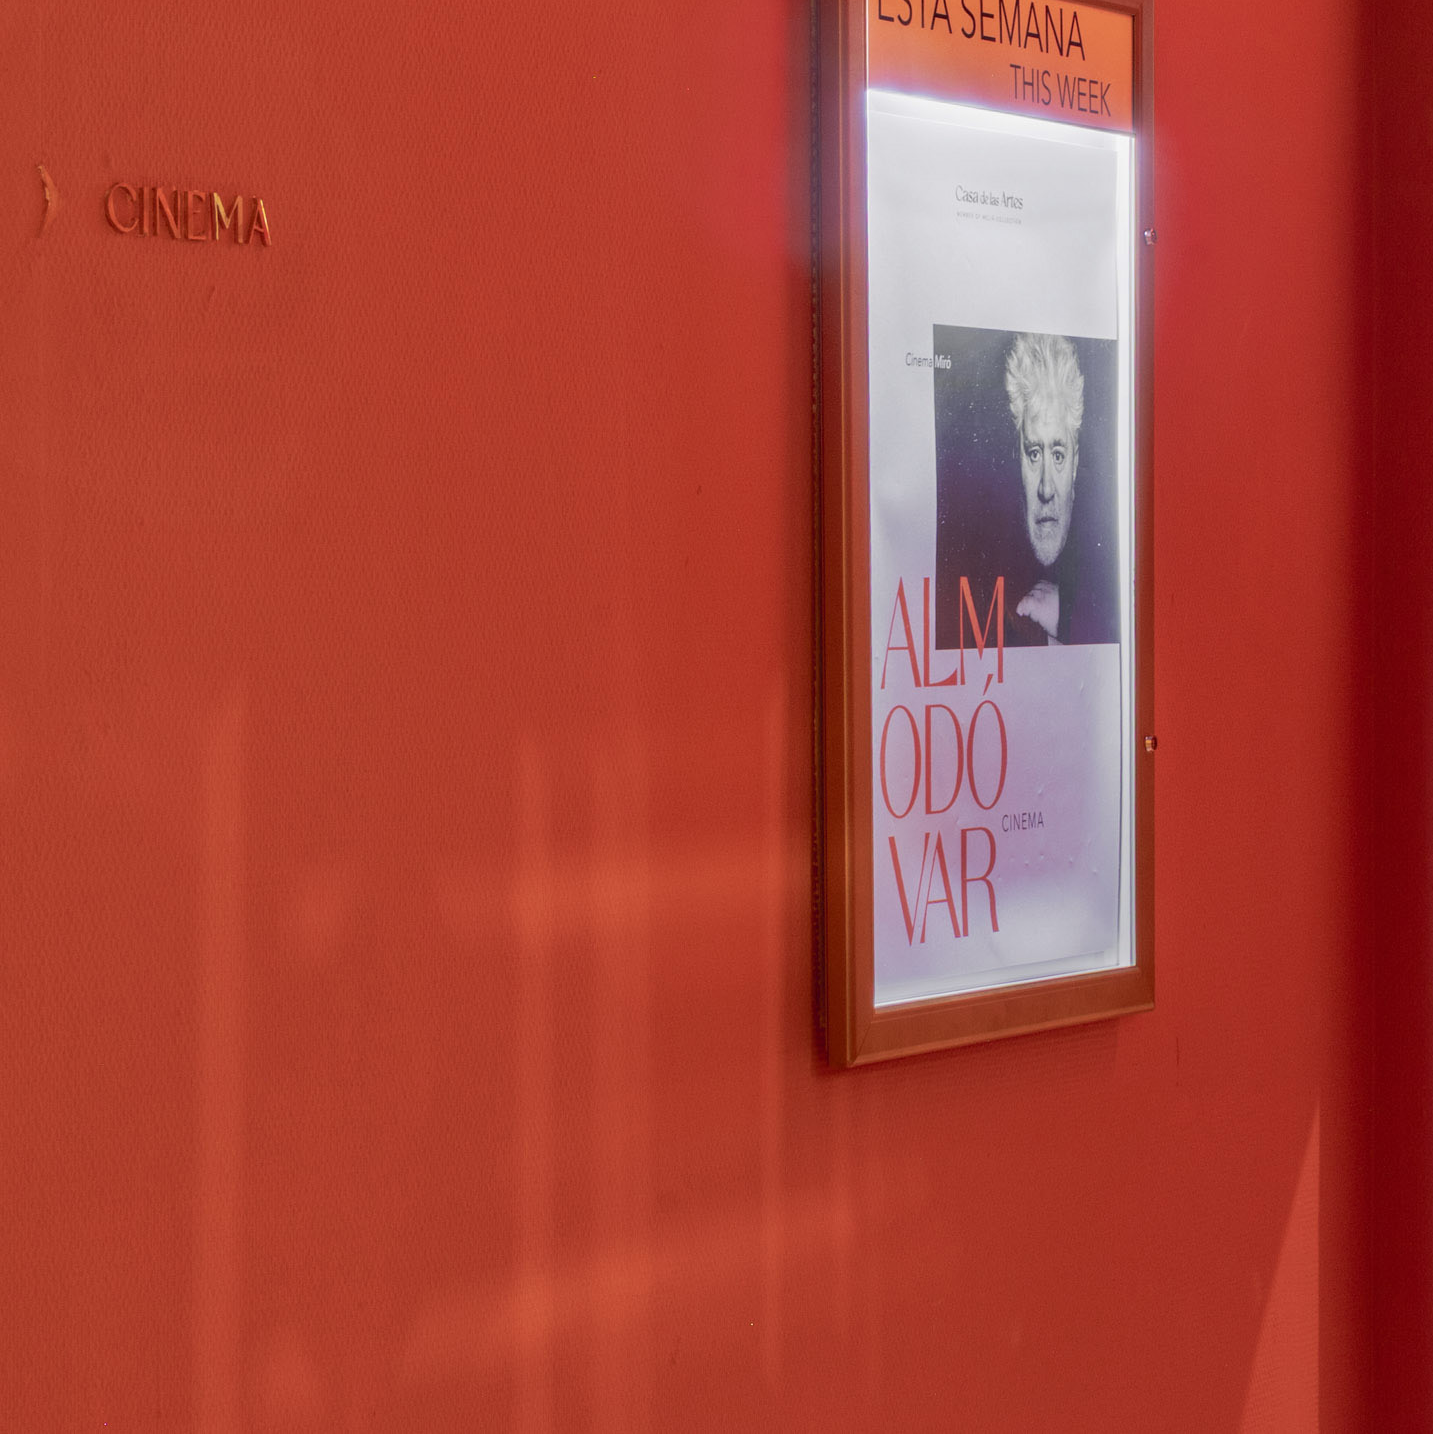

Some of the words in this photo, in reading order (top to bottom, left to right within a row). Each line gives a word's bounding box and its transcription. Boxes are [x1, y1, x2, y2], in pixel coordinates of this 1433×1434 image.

[1009, 63, 1051, 106] THIS
[1057, 74, 1112, 117] WEEK
[104, 181, 272, 247] CINEMA
[955, 184, 979, 204] Casa
[979, 190, 989, 205] de
[989, 191, 1000, 206] las
[1001, 190, 1024, 210] Artes
[905, 352, 933, 368] Cinema
[934, 354, 952, 370] Miró
[881, 576, 1005, 690] ALM
[880, 673, 1008, 820] ODÓ
[1001, 810, 1045, 832] CINEMA
[888, 826, 1000, 947] VAR
